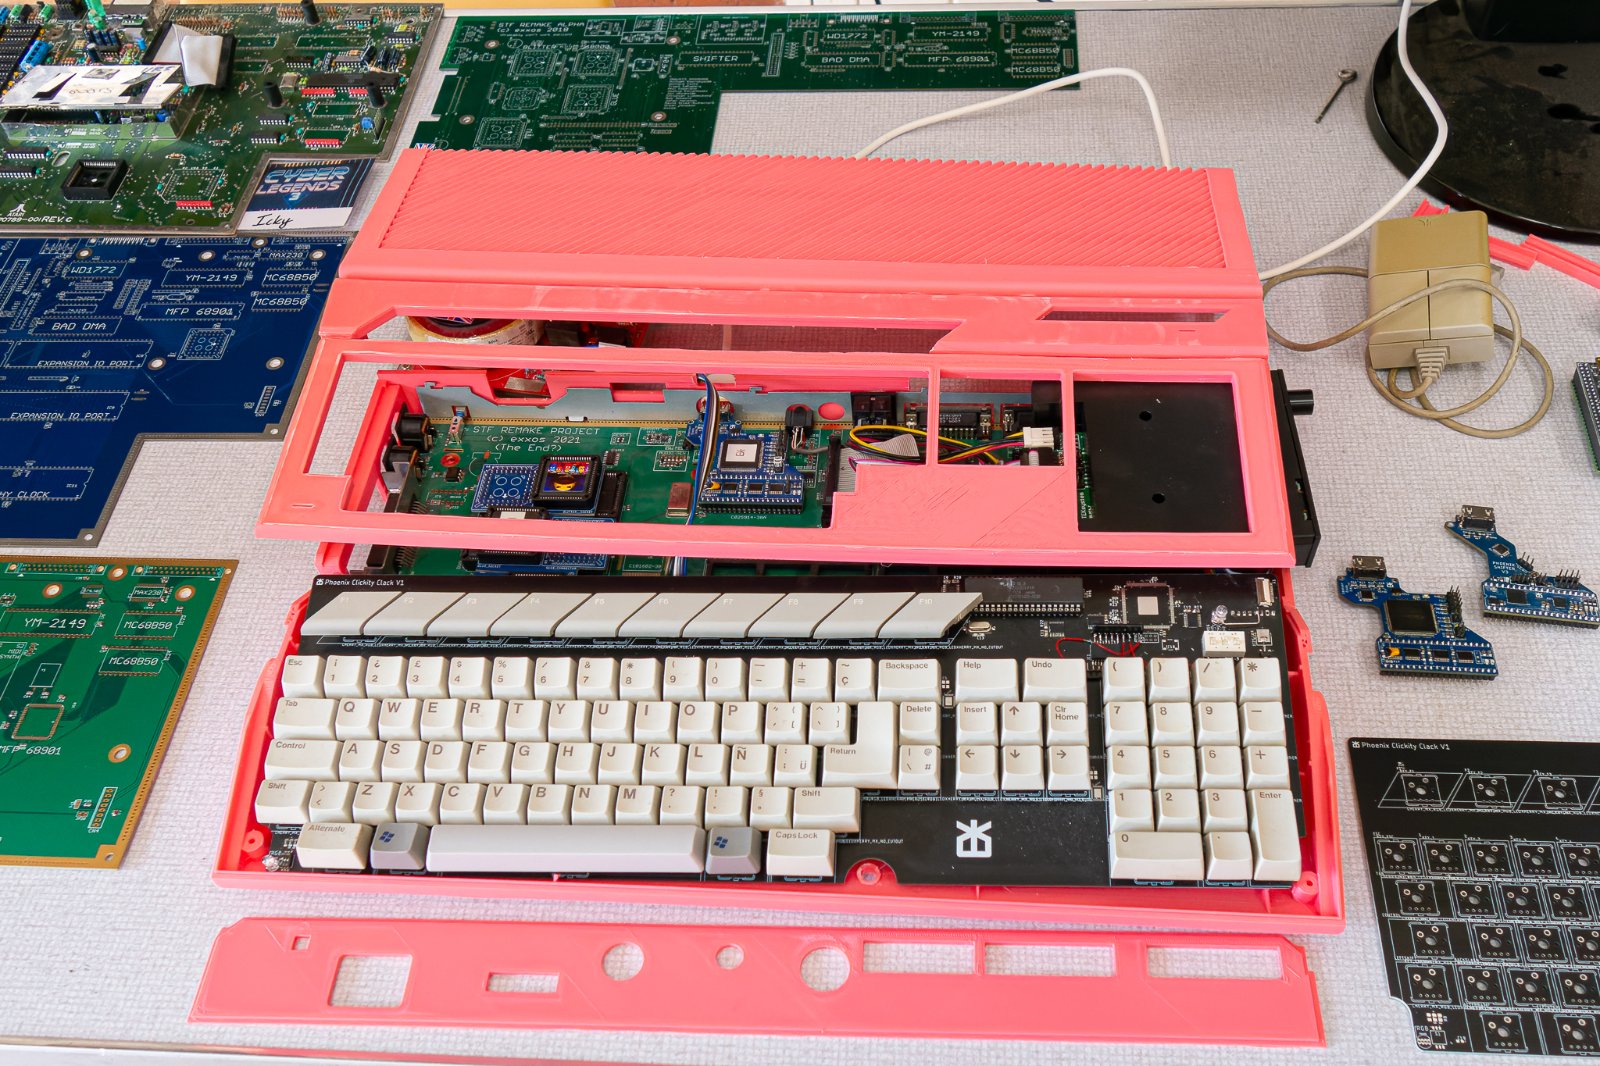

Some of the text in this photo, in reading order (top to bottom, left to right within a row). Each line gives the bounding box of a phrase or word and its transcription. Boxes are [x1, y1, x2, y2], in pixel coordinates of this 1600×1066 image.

[264, 166, 350, 184] CYBER
[255, 181, 343, 194] LEGENDS
[289, 192, 302, 201] 3
[252, 213, 293, 229] Icky
[71, 266, 117, 274] WD1772
[186, 274, 238, 282] YM-2149
[254, 298, 307, 306] MC68B50
[196, 308, 233, 316] 68901
[51, 322, 107, 330] BAD DMA
[473, 426, 600, 435] STF REMAKE PROJECT
[553, 436, 581, 444] 2021
[351, 579, 374, 587] Clickity
[24, 618, 87, 628] YM-2149
[123, 621, 173, 629] MC68B50
[109, 657, 159, 665] MC68B50
[963, 661, 982, 670] Help
[1032, 661, 1052, 669] Undo
[885, 662, 928, 671] Backspace
[372, 675, 378, 683] 2
[413, 675, 419, 683] 3
[583, 676, 589, 684] 7
[625, 676, 632, 685] 8
[670, 676, 676, 684] 9
[712, 676, 718, 684] 0
[343, 702, 355, 714] Q
[387, 702, 401, 713] W
[428, 702, 438, 713] E
[470, 703, 480, 714] R
[514, 703, 524, 714] T
[556, 703, 566, 714] Y
[598, 704, 609, 715] U
[644, 705, 649, 715] I
[684, 704, 696, 715] O
[728, 705, 737, 716] P
[906, 705, 932, 713] Delete
[1114, 706, 1121, 715] 7
[1160, 707, 1167, 715] 8
[1206, 706, 1213, 715] 9
[275, 741, 305, 749] Control
[347, 744, 358, 754] A
[390, 744, 400, 754] S
[1391, 742, 1417, 750] Clickity
[26, 747, 61, 755] 68901
[432, 745, 443, 755] D
[476, 745, 487, 755] F
[519, 745, 529, 756] G
[563, 746, 574, 756] H
[607, 747, 616, 757] J
[650, 747, 660, 757] K
[694, 747, 703, 757] L
[737, 747, 746, 760] Ñ
[1117, 750, 1124, 758] 4
[1163, 750, 1170, 758] 5
[1209, 750, 1216, 758] 6
[362, 785, 372, 795] Z
[404, 786, 414, 796] X
[448, 786, 459, 797] C
[493, 787, 503, 797] V
[536, 787, 546, 798] B
[579, 787, 590, 798] N
[623, 789, 636, 799] M
[1119, 793, 1124, 801] 1
[1165, 793, 1173, 801] 2
[1212, 793, 1219, 801] 3
[1260, 792, 1282, 800] Enter
[308, 825, 345, 833] Alternate
[1121, 834, 1128, 842] 0
